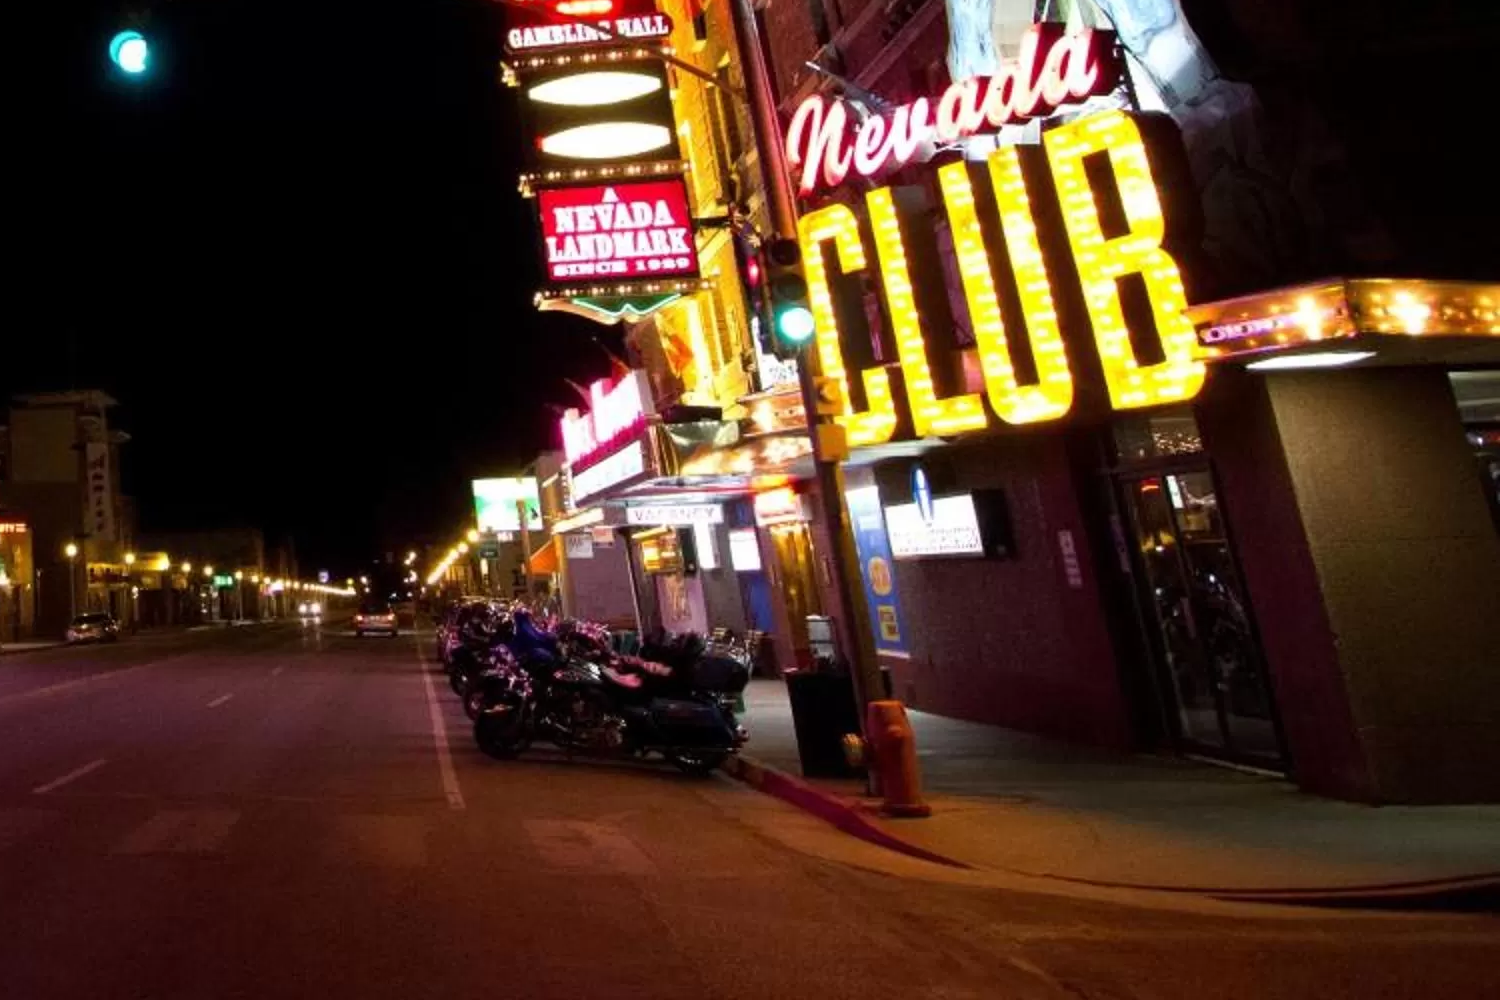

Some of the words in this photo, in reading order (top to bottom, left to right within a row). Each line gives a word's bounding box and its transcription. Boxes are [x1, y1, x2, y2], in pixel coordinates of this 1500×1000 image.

[616, 15, 669, 37] HALL
[785, 26, 1099, 199] Nevada
[602, 187, 619, 203] A
[553, 200, 675, 234] NEVADA
[546, 228, 691, 262] LANDMARK
[553, 260, 629, 277] SINCE
[797, 108, 1208, 447] CLUB
